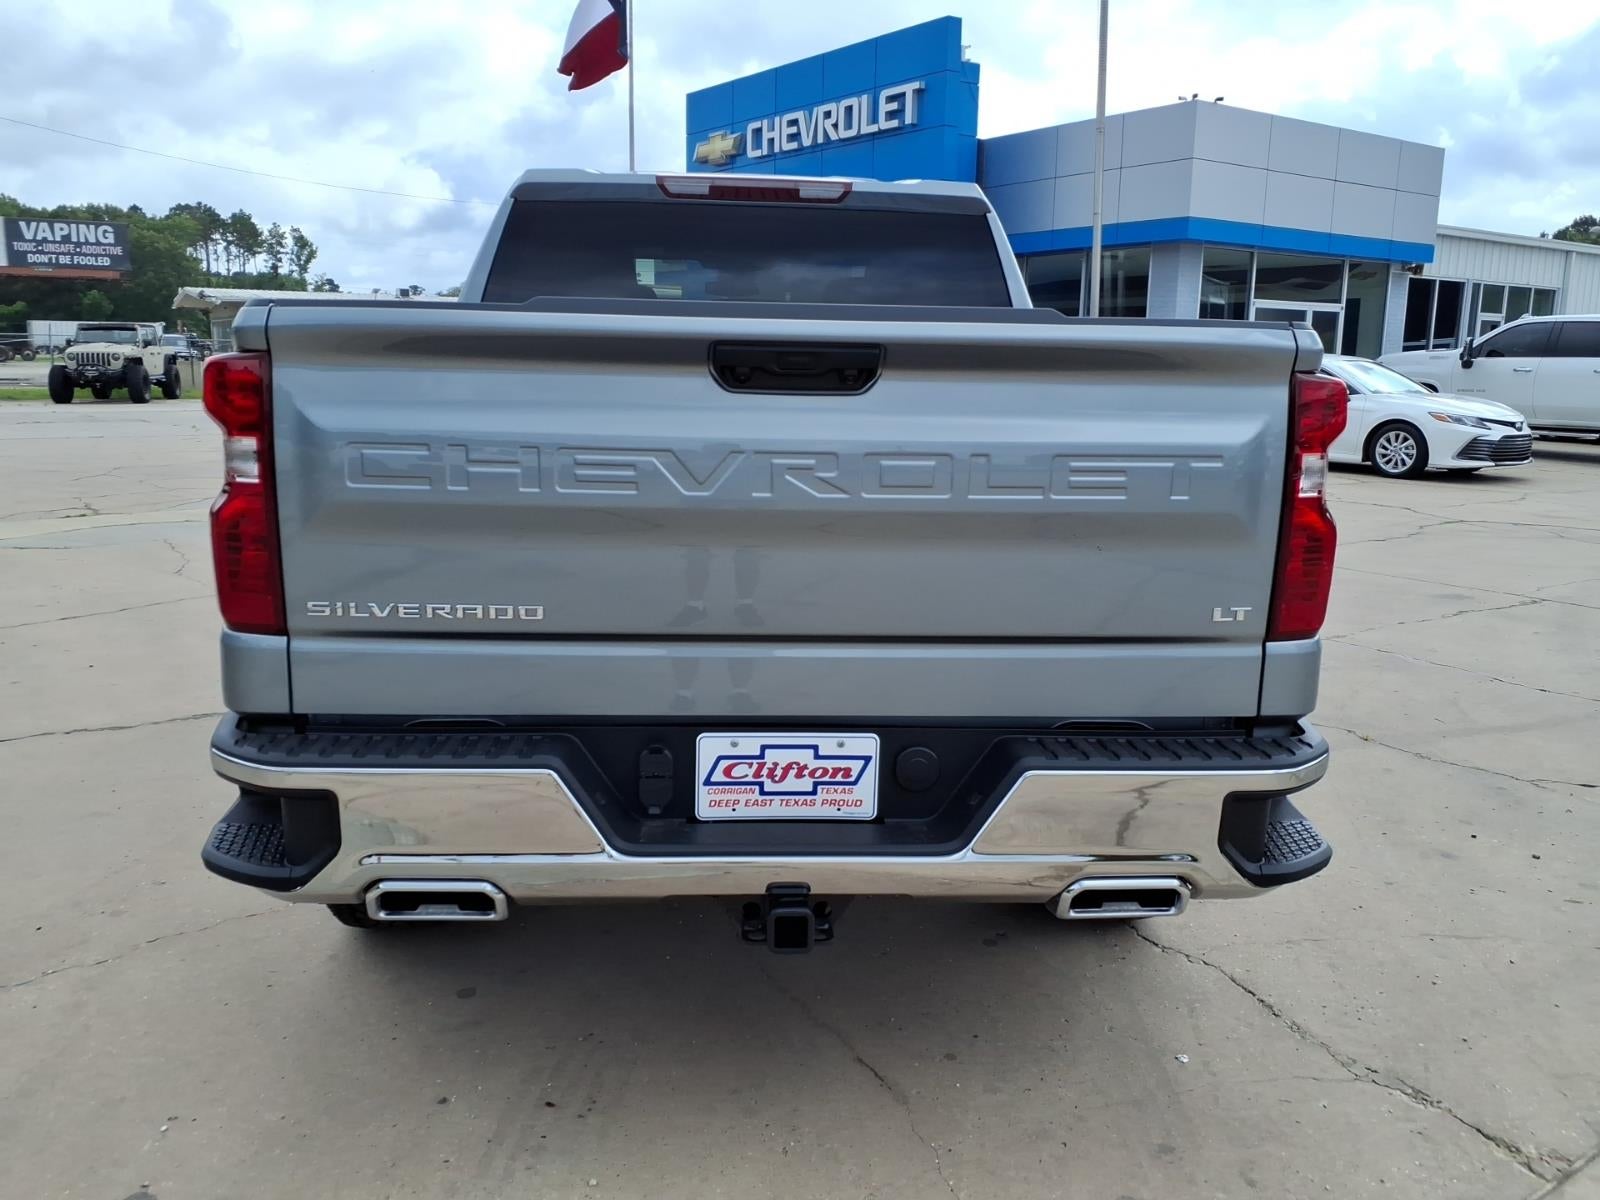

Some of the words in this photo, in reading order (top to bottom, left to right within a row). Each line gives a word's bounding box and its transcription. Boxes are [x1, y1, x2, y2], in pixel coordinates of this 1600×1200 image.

[746, 80, 925, 159] CHEVROLET
[19, 221, 115, 244] VAPING
[12, 242, 37, 252] TOXIC
[43, 243, 75, 253] UNSAFE
[81, 245, 123, 255] ADDICTIVE
[27, 254, 57, 263] DON'T
[59, 255, 72, 264] BE
[73, 256, 111, 266] FOOLED
[344, 440, 1224, 500] CHEVROLET
[306, 601, 544, 620] SILVERADO
[1212, 607, 1253, 622] LT
[722, 761, 853, 784] Clifton
[707, 787, 756, 796] CORRIGAN
[820, 787, 854, 795] TEXAS
[708, 798, 740, 808] DEEP
[744, 798, 775, 808] EAST
[779, 798, 817, 807] TEXAS
[820, 798, 863, 808] PROUD
